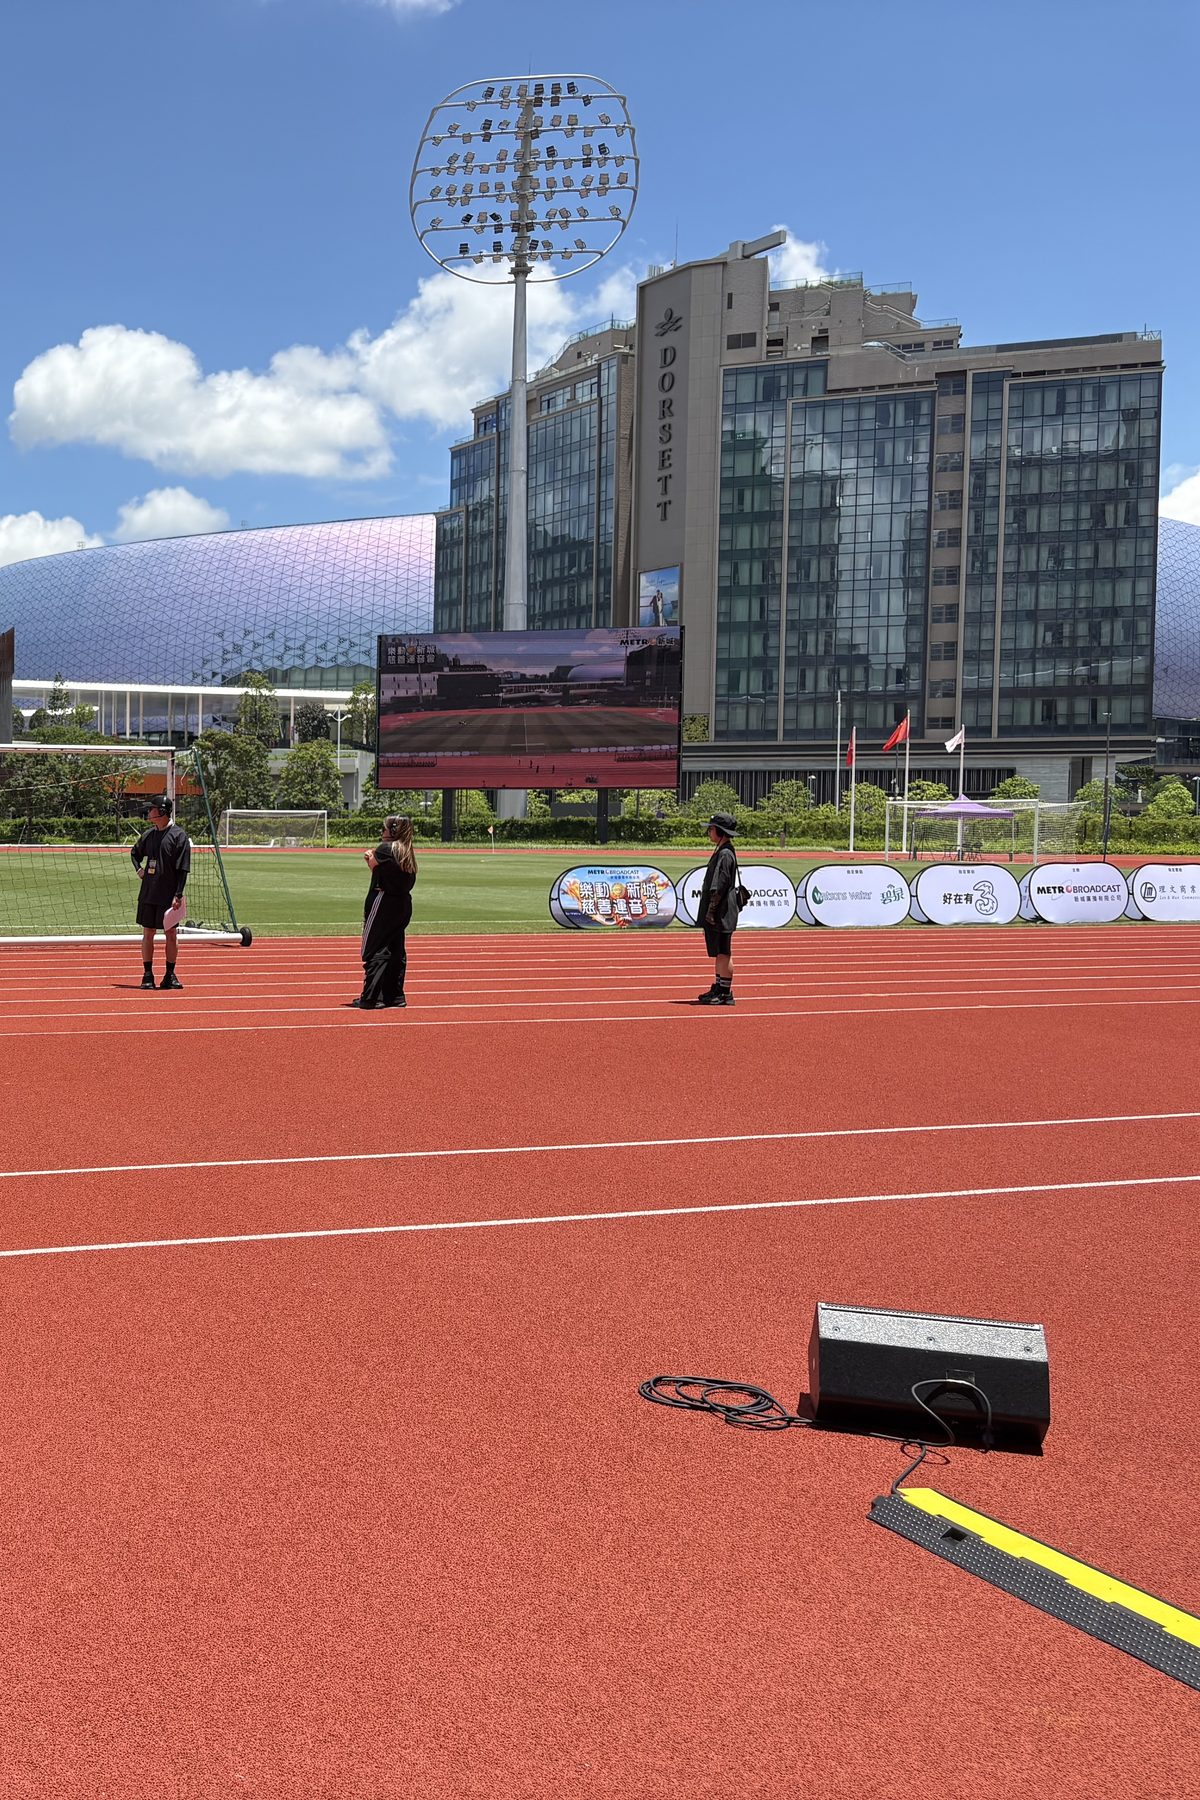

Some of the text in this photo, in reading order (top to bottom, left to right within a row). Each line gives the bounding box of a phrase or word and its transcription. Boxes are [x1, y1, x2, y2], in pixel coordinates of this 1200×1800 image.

[656, 345, 676, 522] DORSETT
[581, 899, 659, 915] 慈善運音會
[942, 892, 974, 905] 好在有
[973, 880, 999, 916] 3
